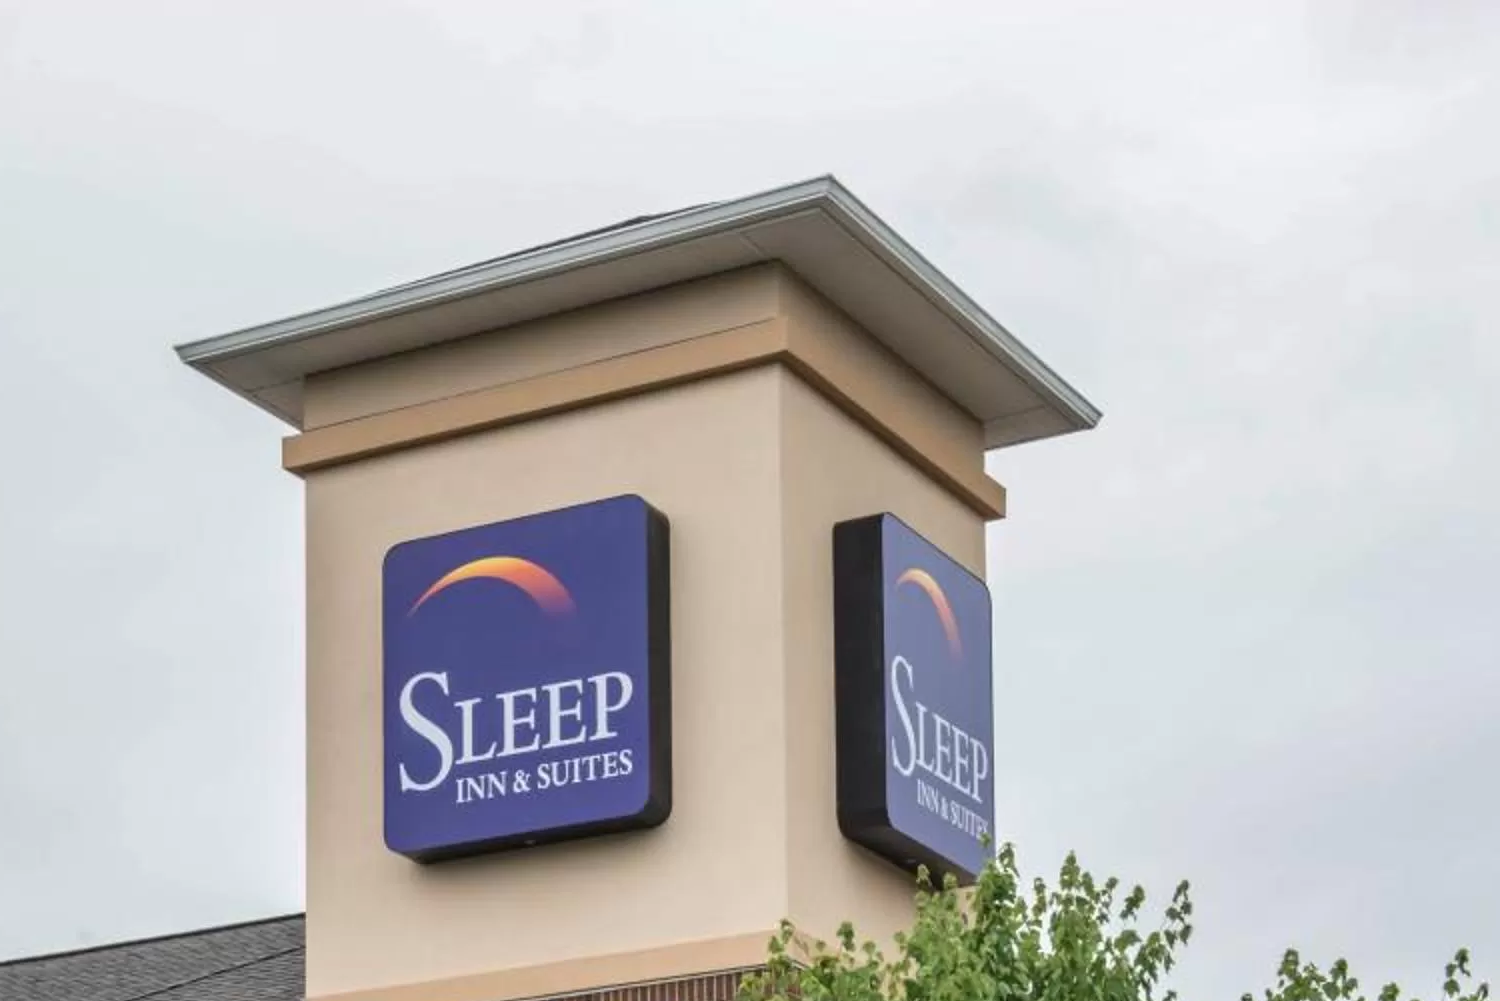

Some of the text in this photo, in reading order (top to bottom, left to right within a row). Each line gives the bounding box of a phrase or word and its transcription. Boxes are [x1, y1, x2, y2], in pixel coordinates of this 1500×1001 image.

[399, 671, 633, 792] SLEEP
[891, 655, 988, 804] SLEEP
[455, 749, 633, 803] INN & SUITES
[916, 778, 939, 814] INN
